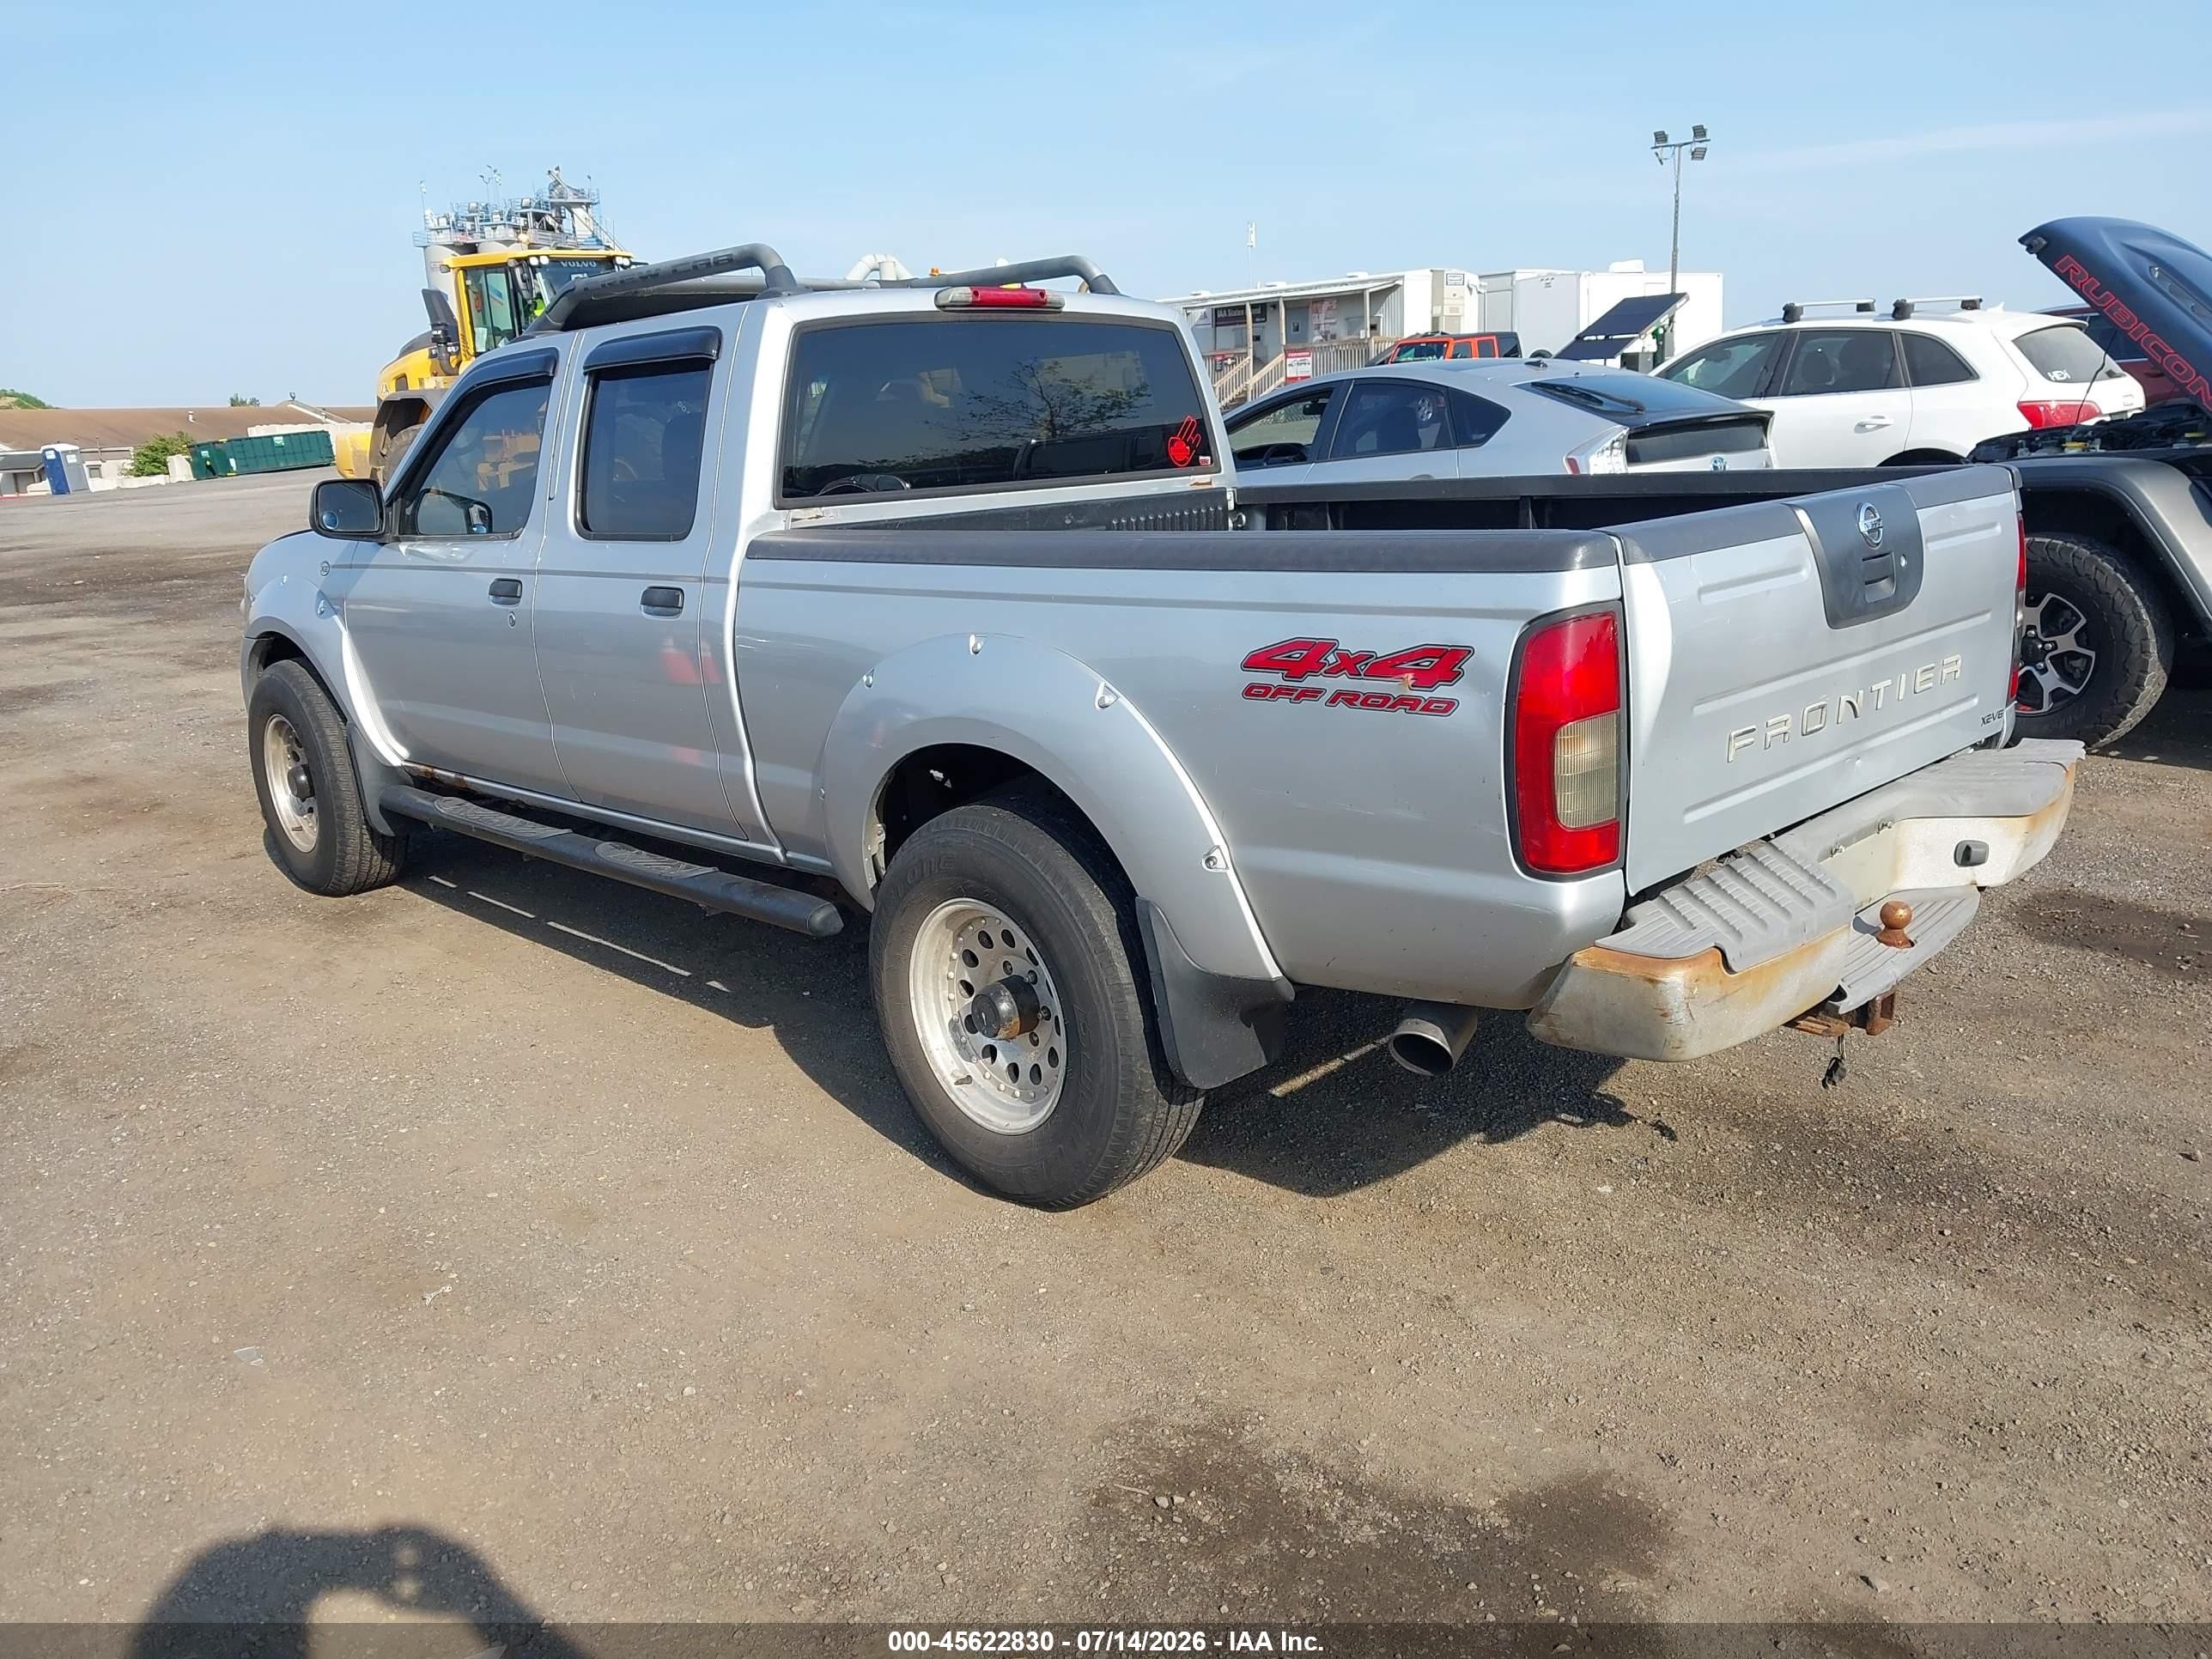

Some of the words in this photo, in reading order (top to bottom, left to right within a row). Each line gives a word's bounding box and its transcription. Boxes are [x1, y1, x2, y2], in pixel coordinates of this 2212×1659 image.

[1241, 637, 1474, 692] 4x4
[1242, 682, 1327, 703] OFF
[1324, 690, 1460, 717] ROAD
[1728, 654, 1961, 763] FRONTIER
